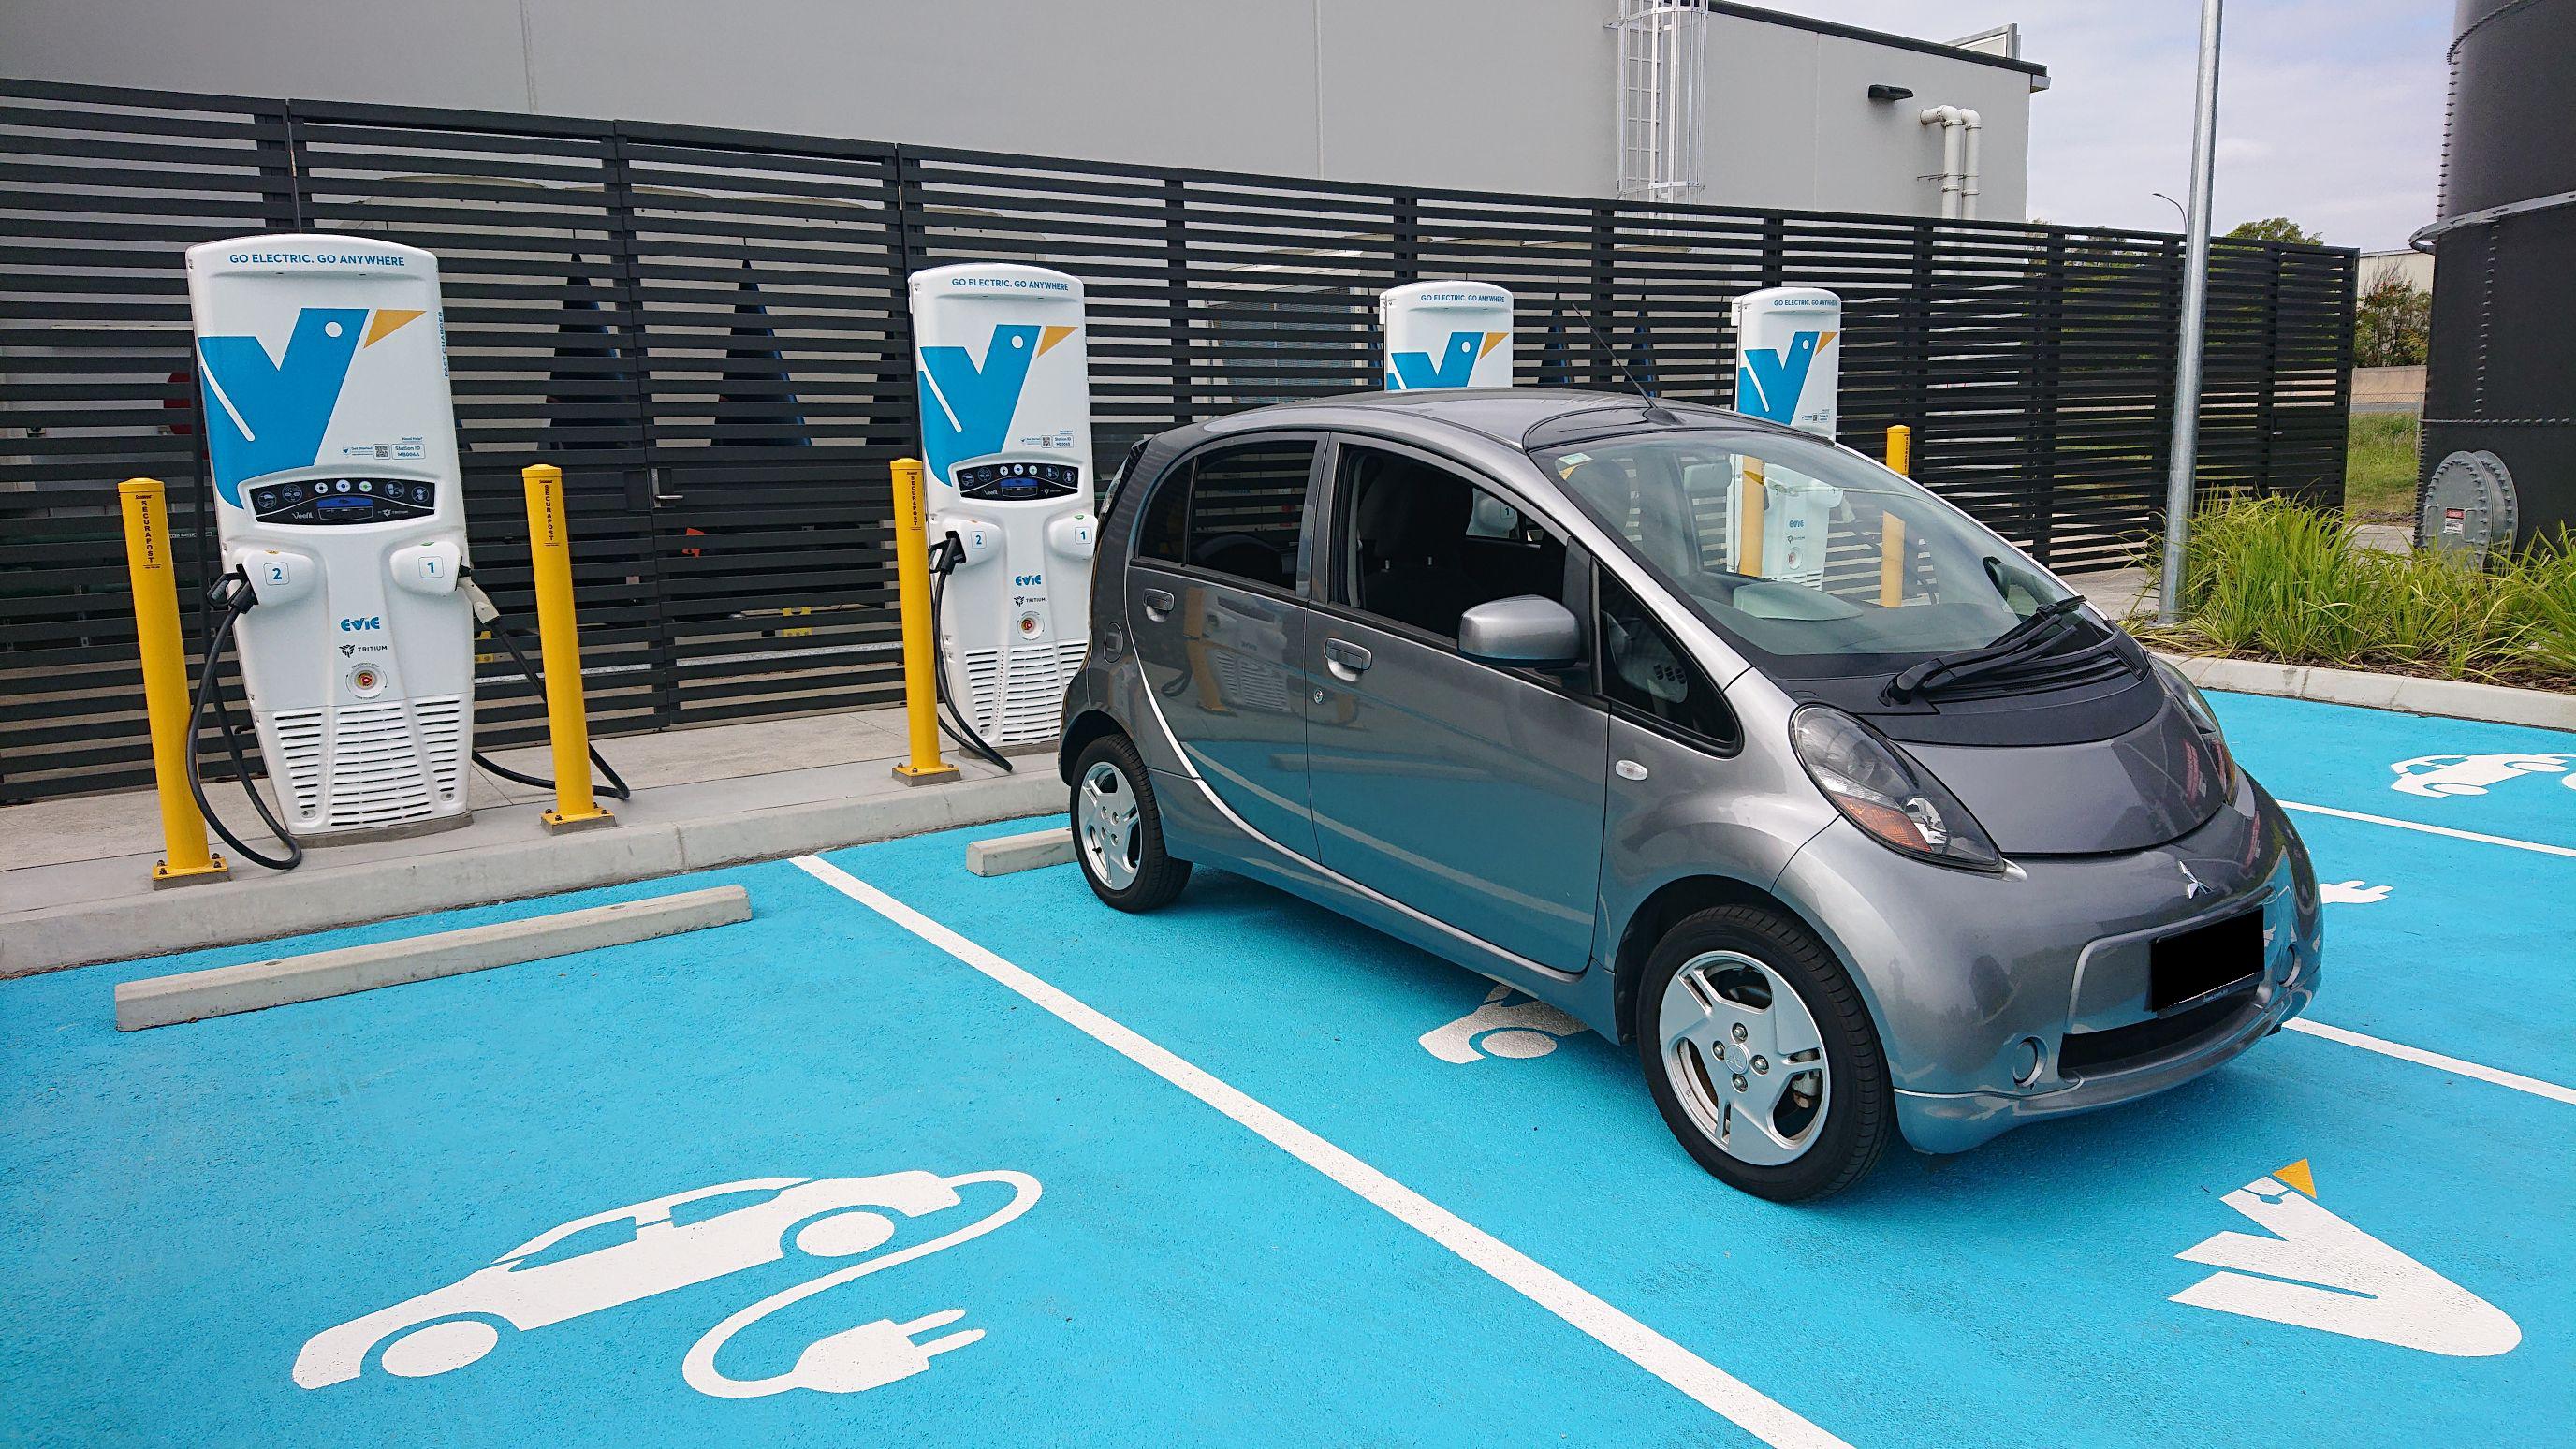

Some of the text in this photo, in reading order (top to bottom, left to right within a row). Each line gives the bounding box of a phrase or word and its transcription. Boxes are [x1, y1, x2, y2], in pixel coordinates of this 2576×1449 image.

[229, 254, 405, 267] GO ELECTRIC. GO ANYWHERE
[951, 278, 1069, 291] GO ELECTRIC. GO ANYWHERE
[544, 484, 554, 541] SECURAPOST
[1505, 507, 1510, 516] 1
[141, 500, 154, 563] SECURAPOST
[1080, 531, 1087, 540] 1
[975, 534, 983, 545] 2
[271, 567, 283, 580] 2
[427, 562, 435, 574] 1
